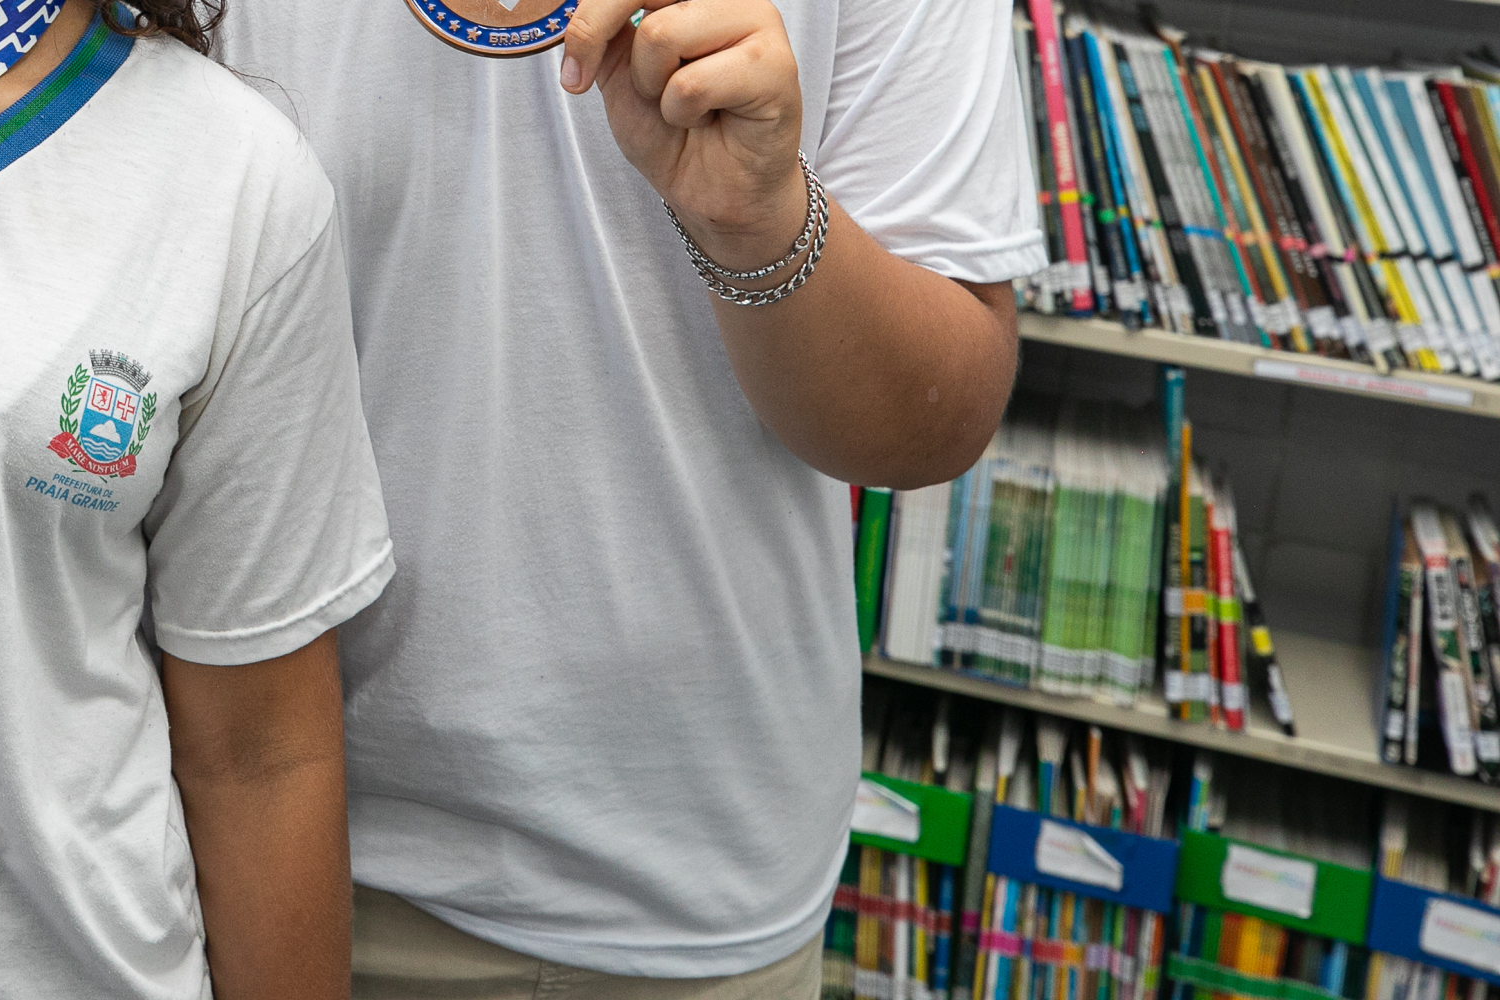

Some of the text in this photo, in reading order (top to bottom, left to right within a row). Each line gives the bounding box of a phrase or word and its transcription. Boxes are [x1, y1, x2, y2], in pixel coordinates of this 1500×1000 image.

[488, 28, 546, 45] BRASIL
[66, 438, 130, 474] MARE NOSTRUM
[24, 476, 121, 513] PRAIA GRANDE
[52, 472, 114, 499] PREFEITURA DE
